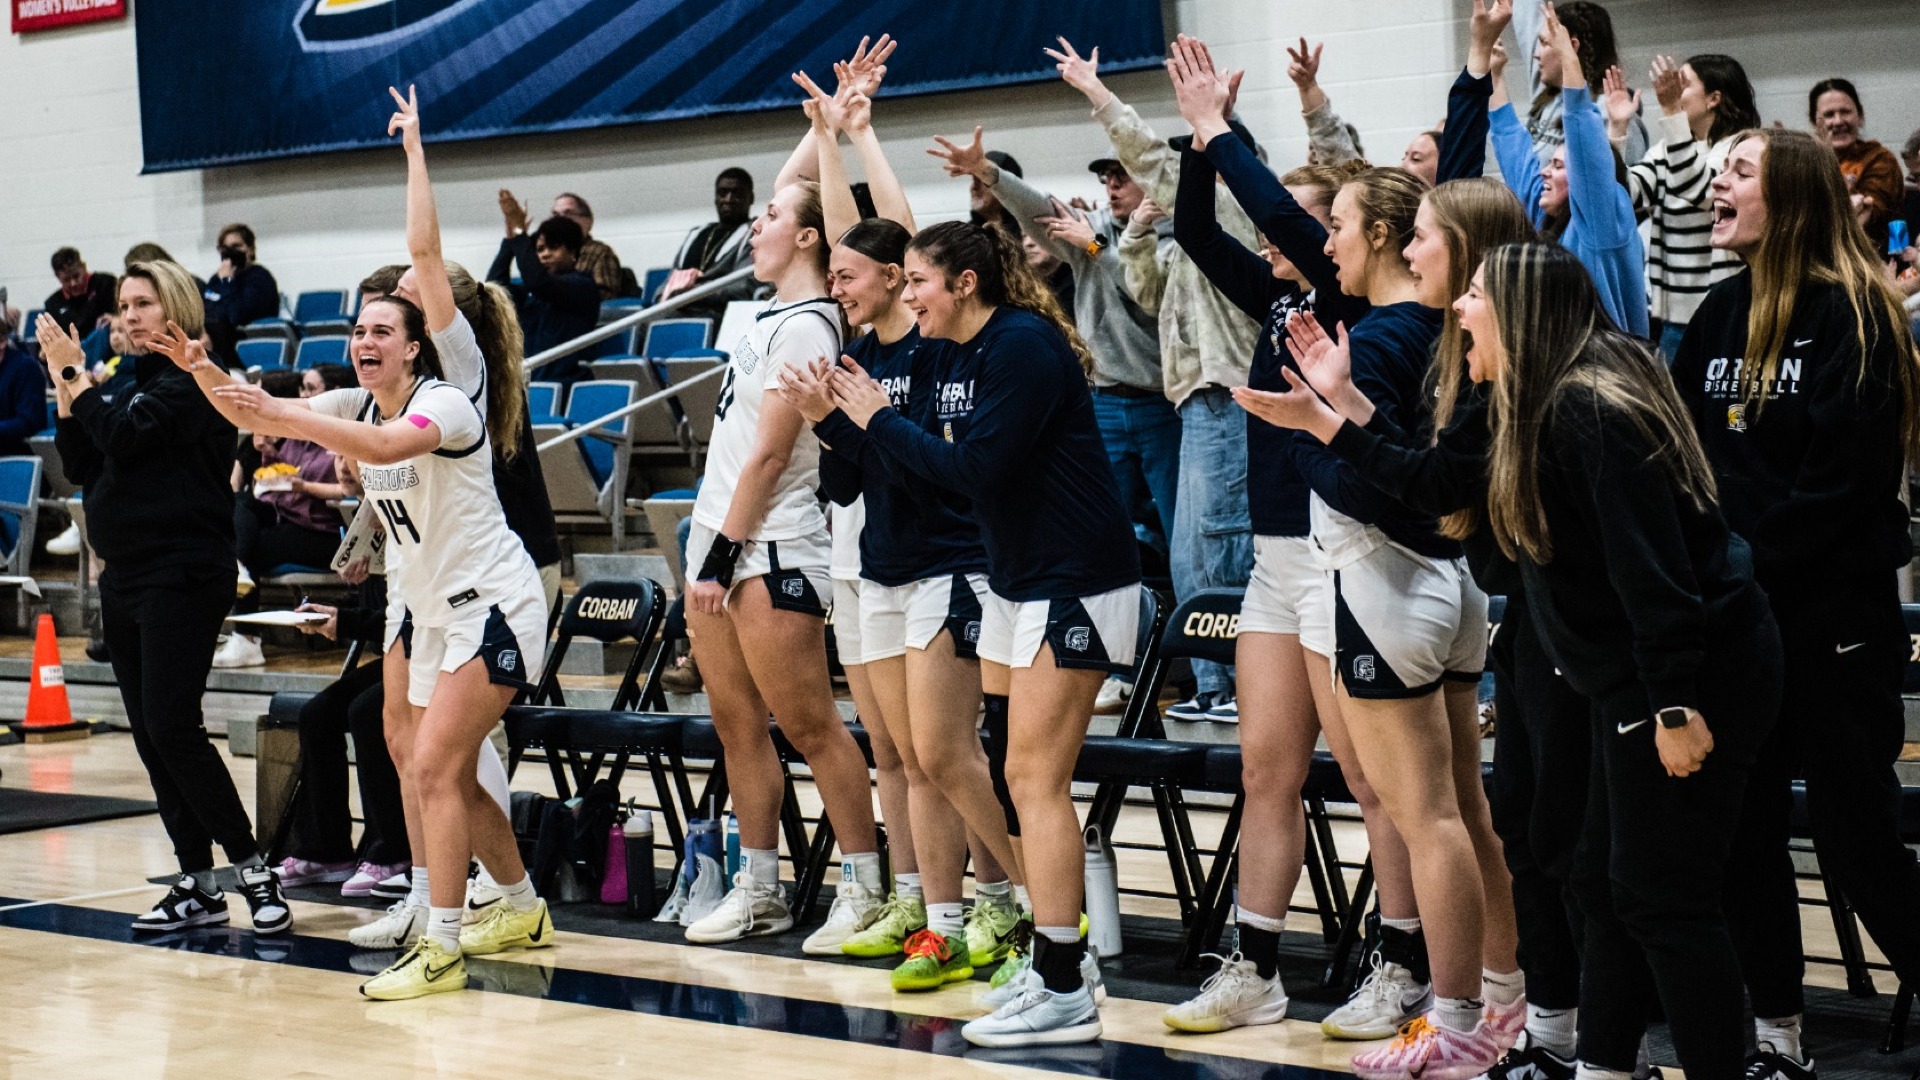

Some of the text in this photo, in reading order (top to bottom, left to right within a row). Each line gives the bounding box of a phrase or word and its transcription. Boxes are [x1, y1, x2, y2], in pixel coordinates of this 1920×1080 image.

[63, 0, 118, 13] VOLLEY
[377, 499, 421, 545] 14
[578, 596, 639, 620] CORBAN
